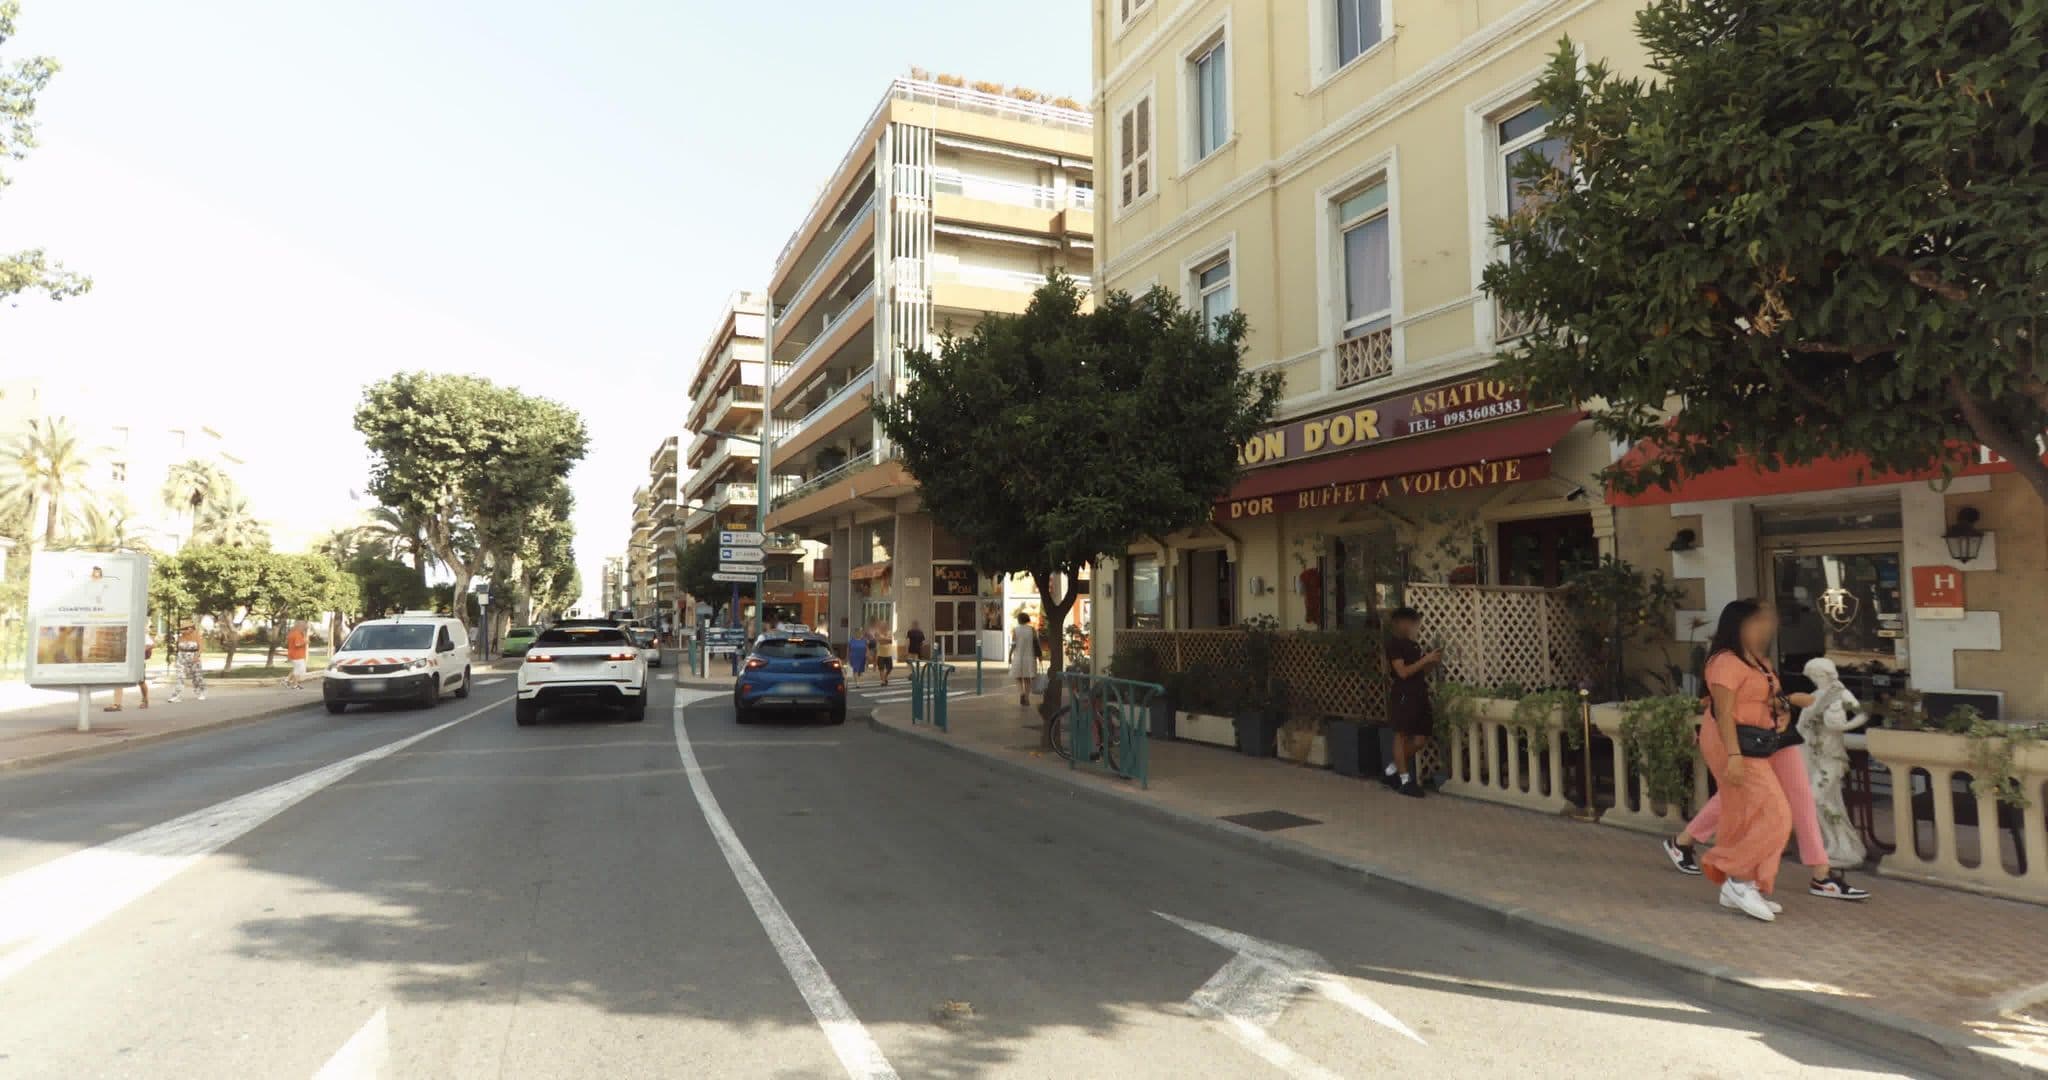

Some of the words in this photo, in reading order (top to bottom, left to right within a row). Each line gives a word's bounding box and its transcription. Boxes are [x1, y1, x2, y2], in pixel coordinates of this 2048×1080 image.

[1408, 418, 1436, 433] TEL:
[1443, 398, 1521, 426] 0983608383
[1410, 379, 1514, 417] ASIATIQ
[1304, 409, 1380, 452] D'OR
[1231, 497, 1274, 519] D'OR
[1299, 482, 1369, 509] BUFFET
[1375, 479, 1390, 498] A
[1400, 459, 1520, 495] VOLONTE
[1934, 573, 1955, 589] H
